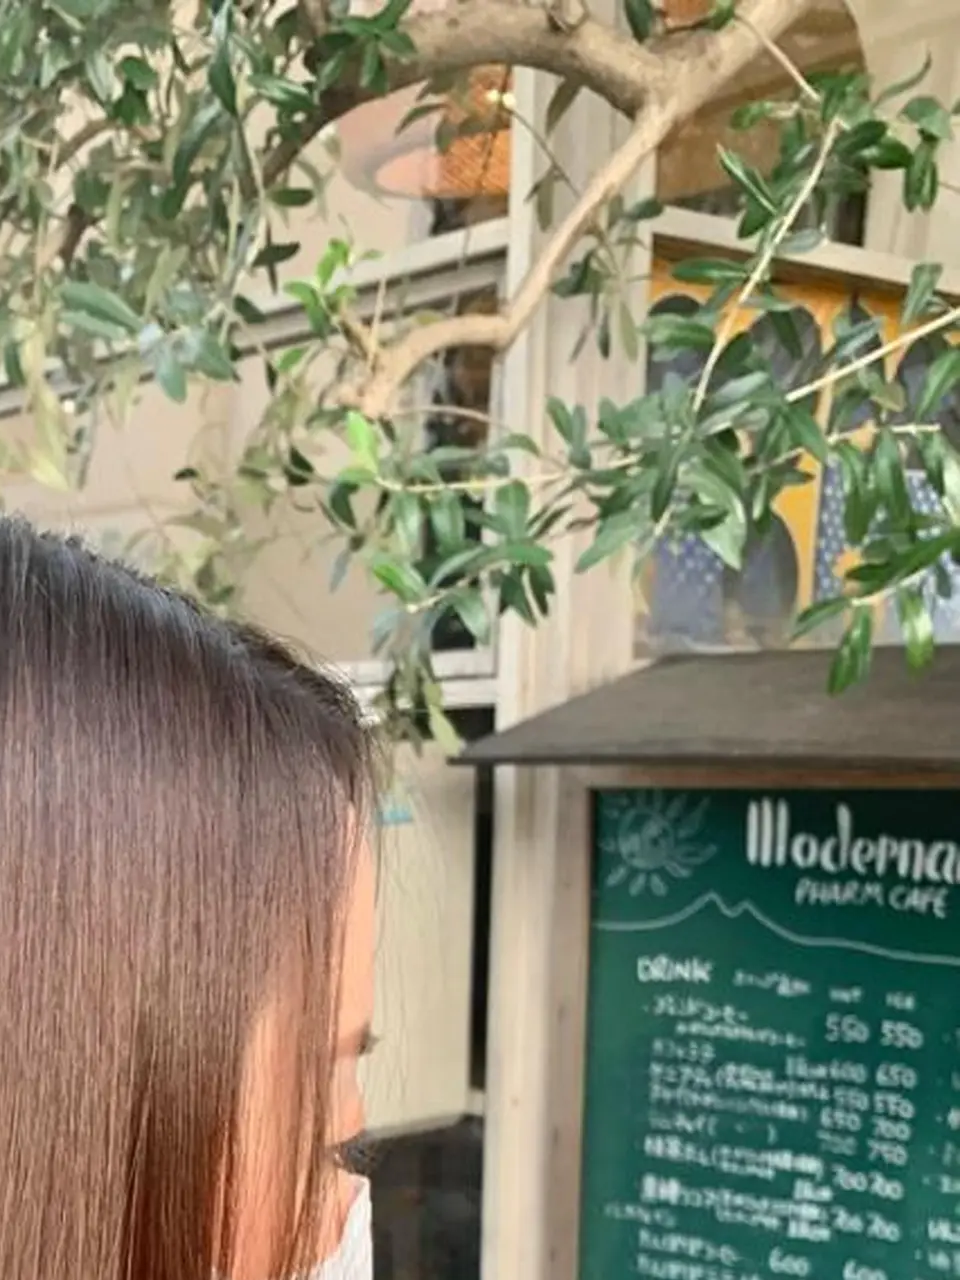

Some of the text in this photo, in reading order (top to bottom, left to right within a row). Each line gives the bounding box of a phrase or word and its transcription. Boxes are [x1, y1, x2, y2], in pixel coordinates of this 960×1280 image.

[746, 797, 960, 885] Moderna
[888, 883, 949, 919] CAFE
[637, 953, 715, 985] DRINK
[880, 1018, 924, 1050] 550
[768, 1245, 811, 1278] 600
